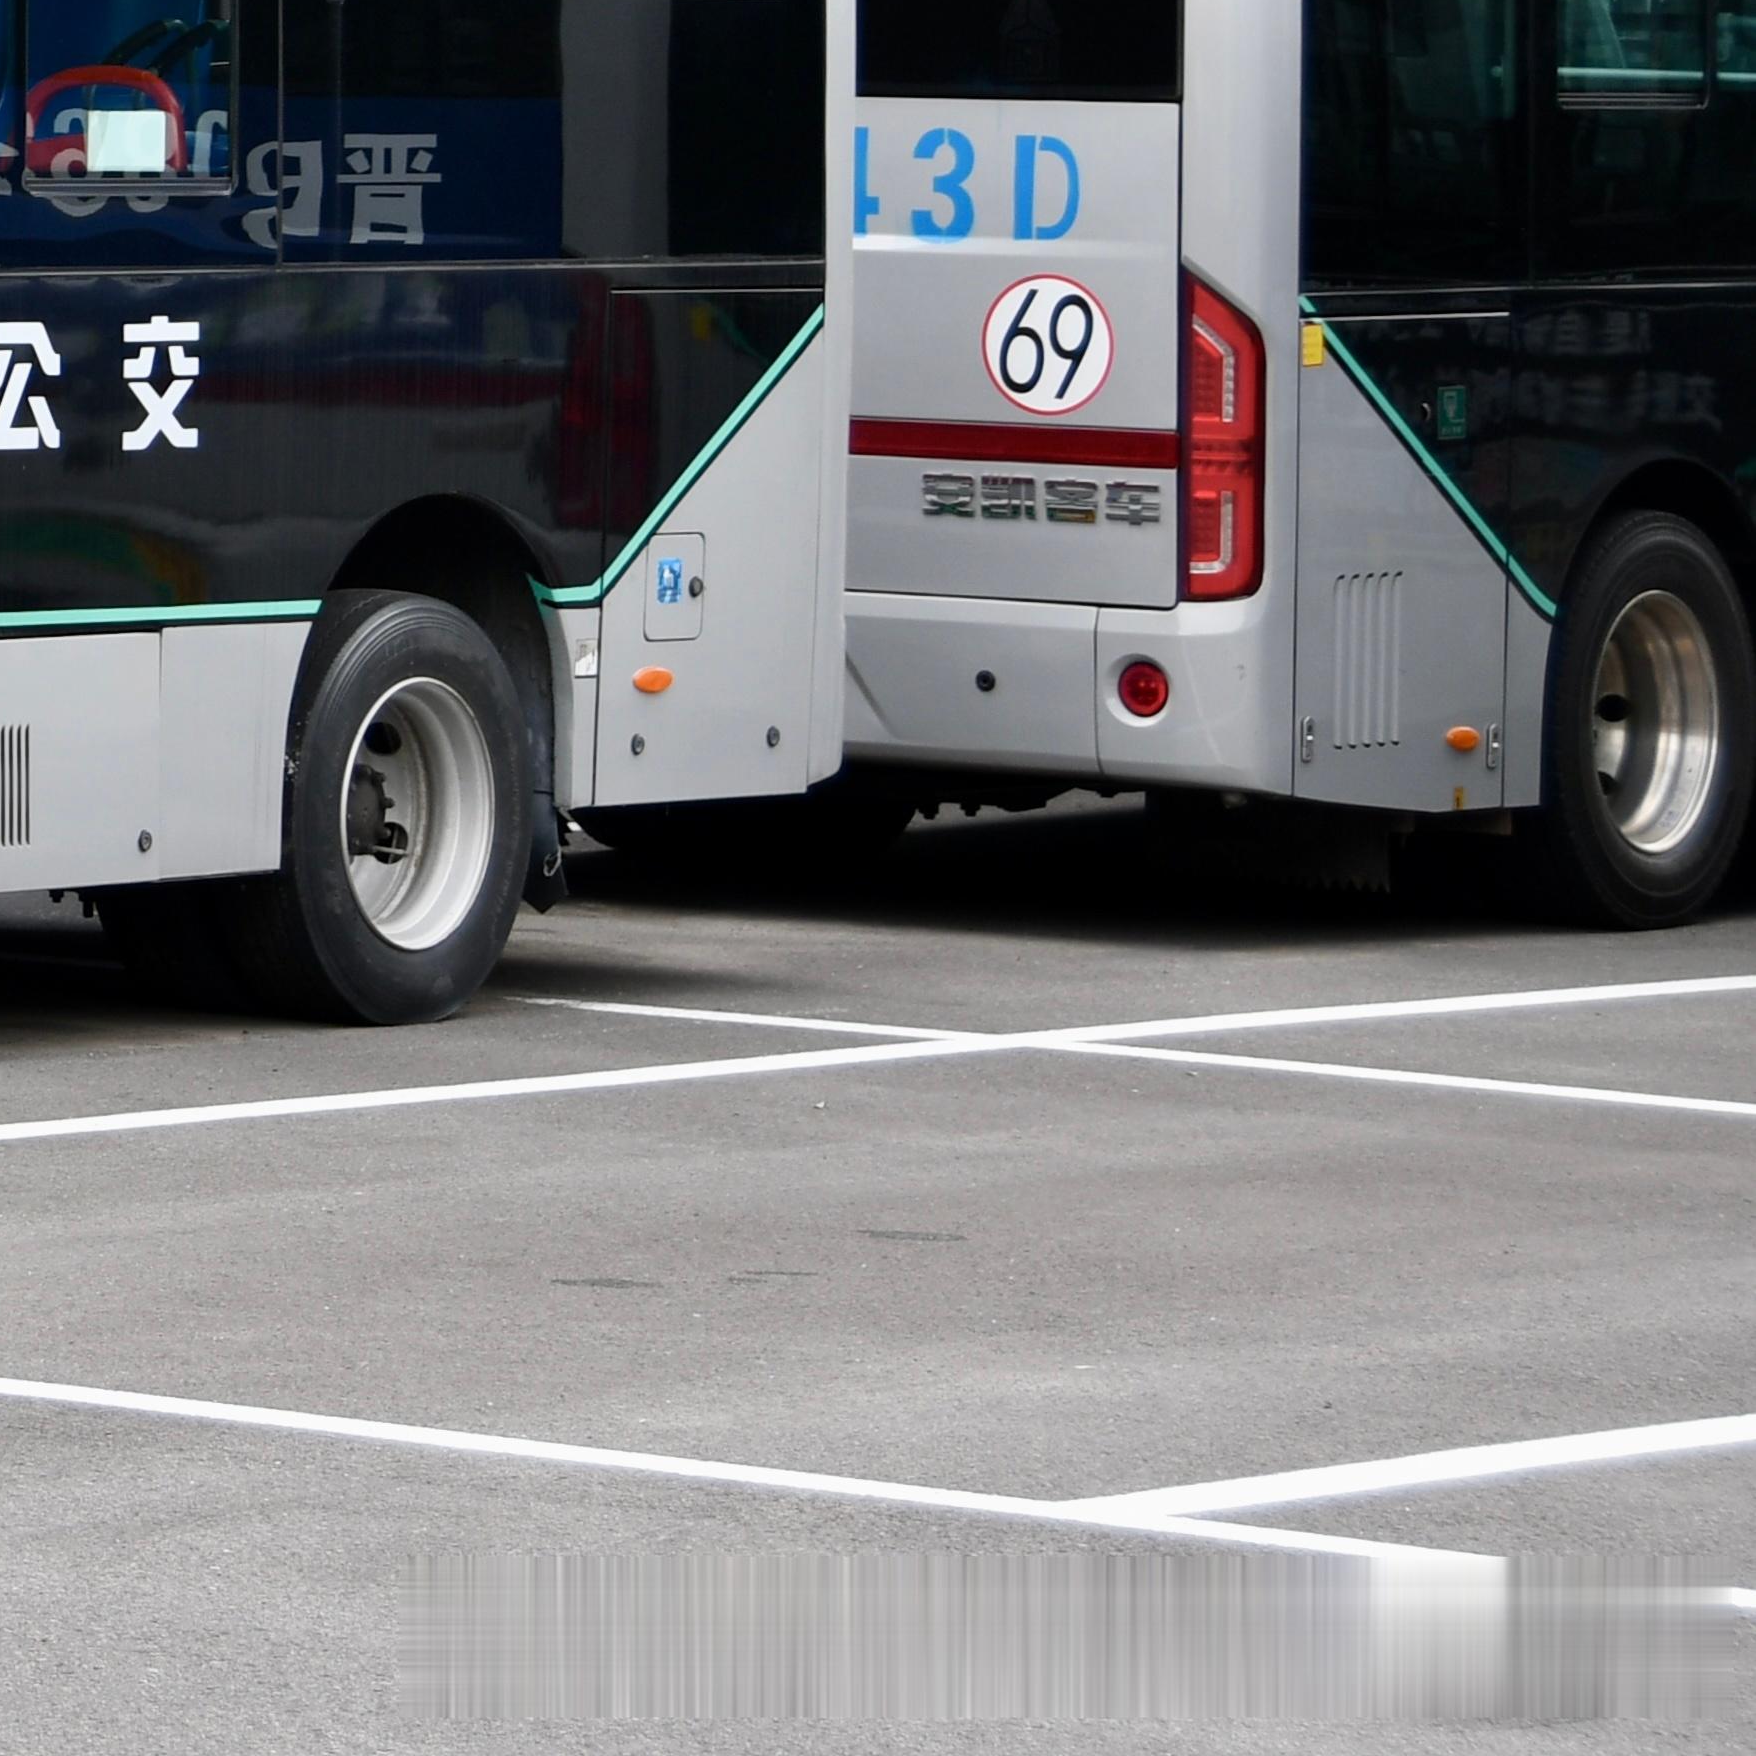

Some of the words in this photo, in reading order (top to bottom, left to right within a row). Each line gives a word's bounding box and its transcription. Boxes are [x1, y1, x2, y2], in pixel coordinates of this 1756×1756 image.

[999, 289, 1094, 400] 69
[922, 473, 1161, 526] 安凯客车
